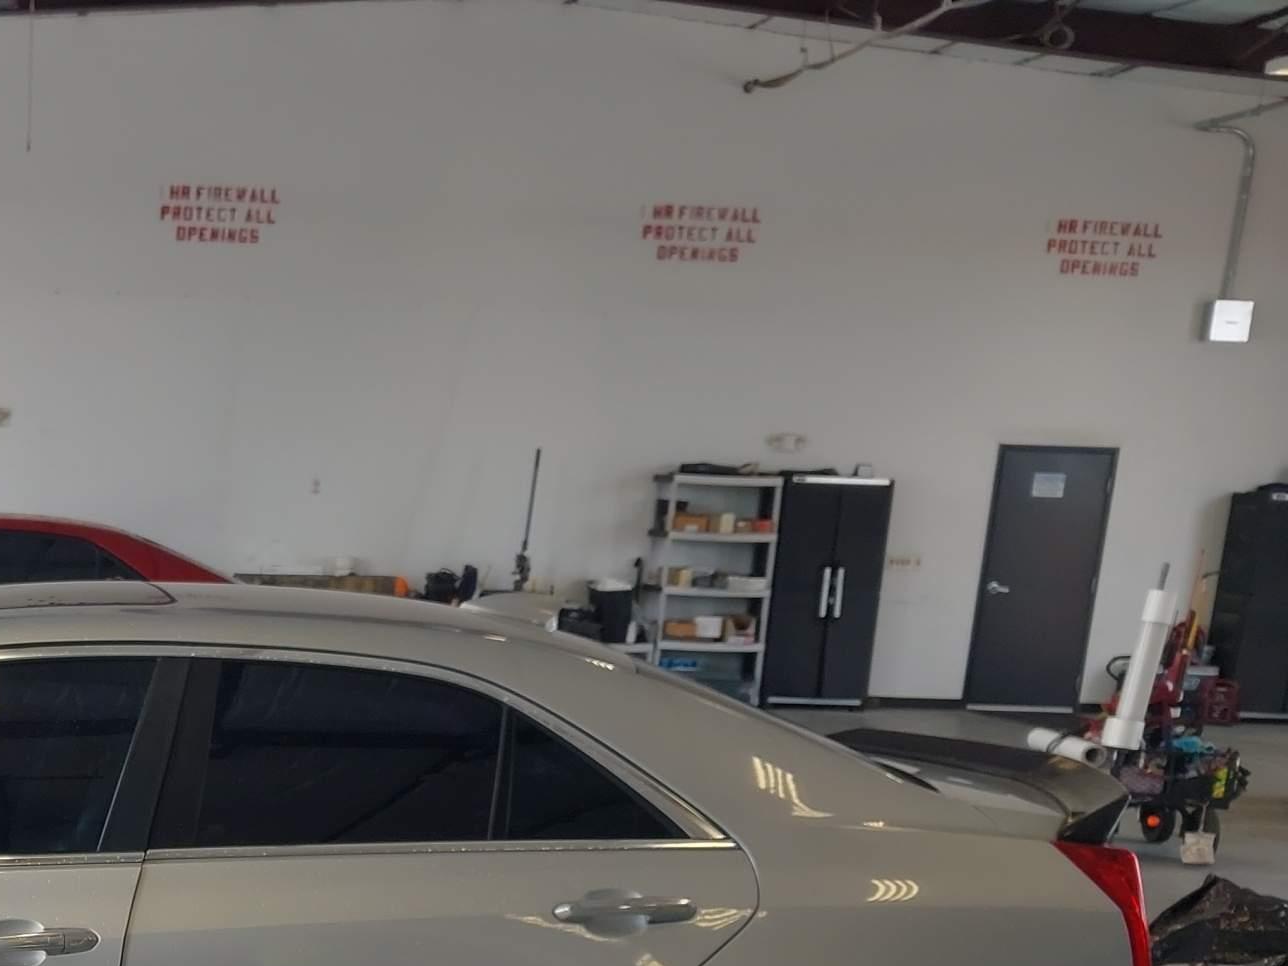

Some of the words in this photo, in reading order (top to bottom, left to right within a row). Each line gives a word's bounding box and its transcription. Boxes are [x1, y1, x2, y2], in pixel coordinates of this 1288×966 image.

[196, 186, 280, 204] FIREWALL
[160, 205, 236, 222] PROTECT
[245, 208, 276, 224] ALL
[678, 205, 760, 223] FIREWALL
[176, 226, 259, 243] OPENINGS
[642, 225, 718, 241] PROTECT
[725, 227, 756, 243] ALL
[1082, 220, 1163, 238] FIREWALL
[656, 246, 738, 262] OPENINGS
[1047, 238, 1120, 256] PROTECT
[1127, 242, 1156, 258] ALL
[1059, 259, 1140, 276] OPENINGS
